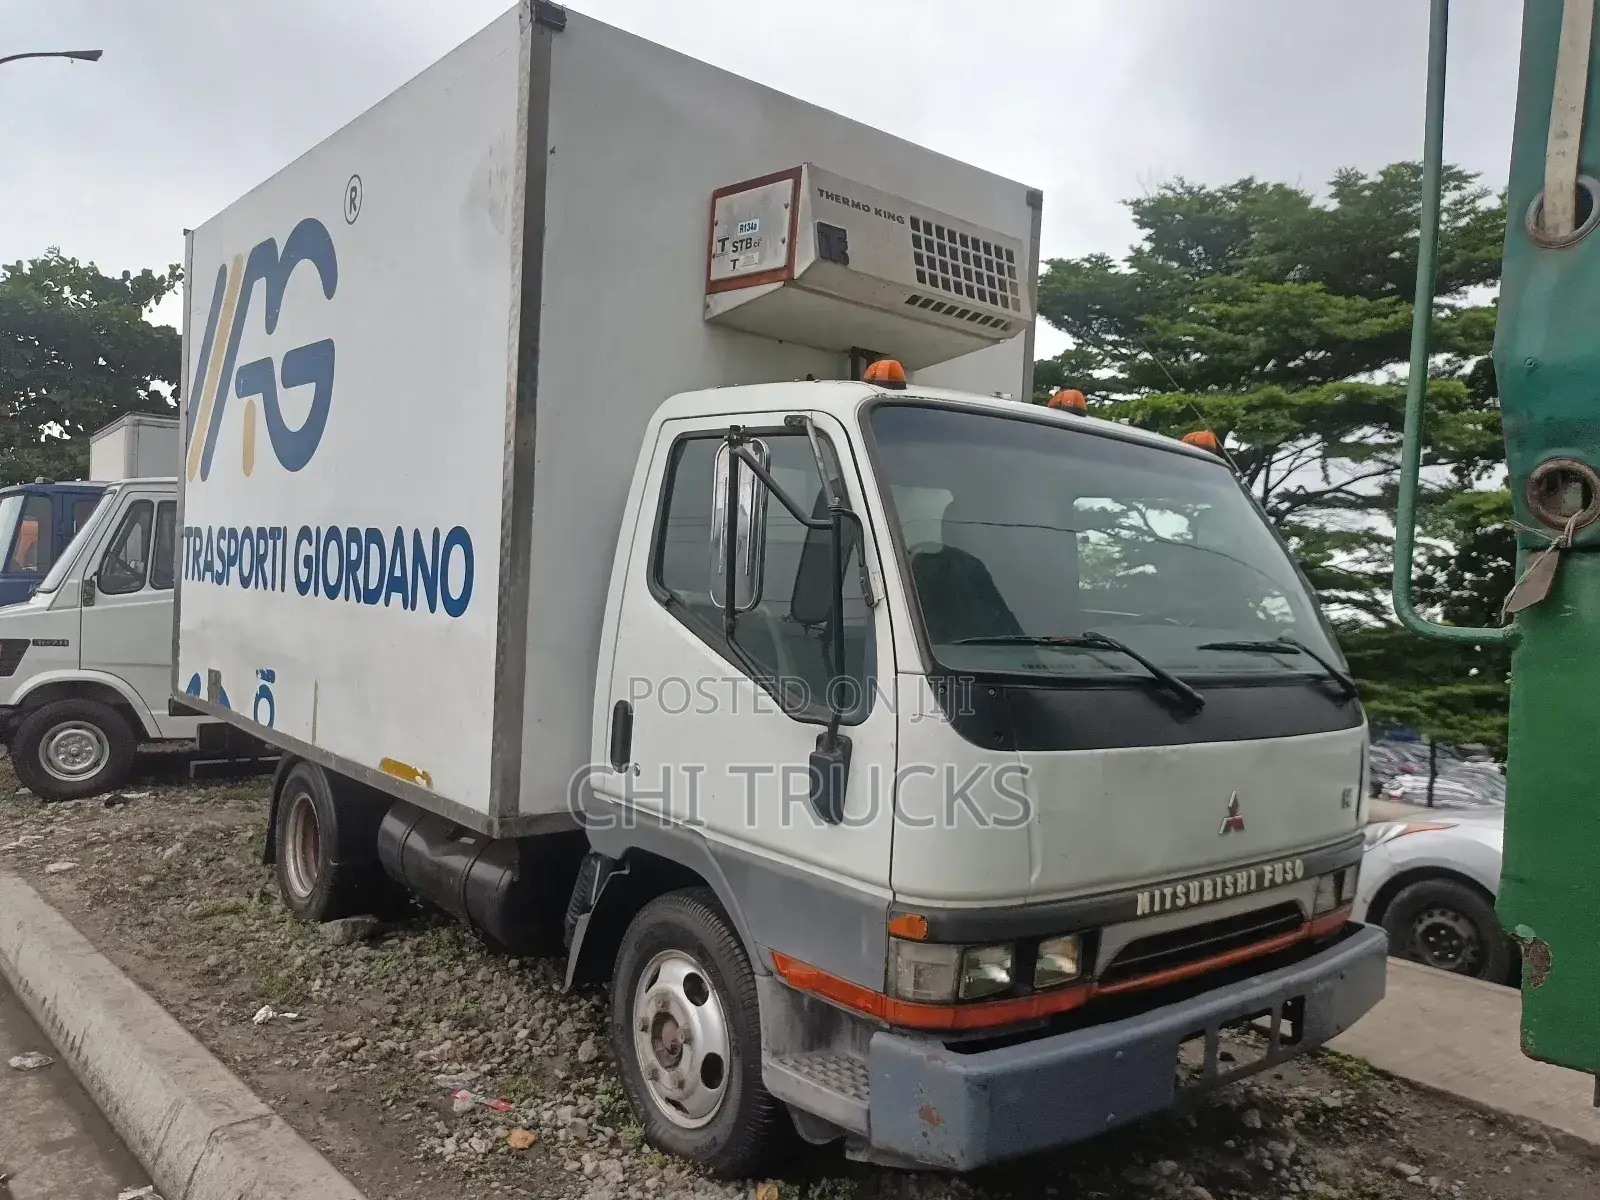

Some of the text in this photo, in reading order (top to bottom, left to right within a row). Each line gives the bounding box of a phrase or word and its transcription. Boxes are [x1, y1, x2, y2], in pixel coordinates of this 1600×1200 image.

[739, 221, 758, 234] R134a
[817, 187, 905, 225] THERMO KING
[184, 525, 475, 618] TRASPORTI GIORDANO
[1136, 858, 1305, 917] MITSUBISHI FUSO
